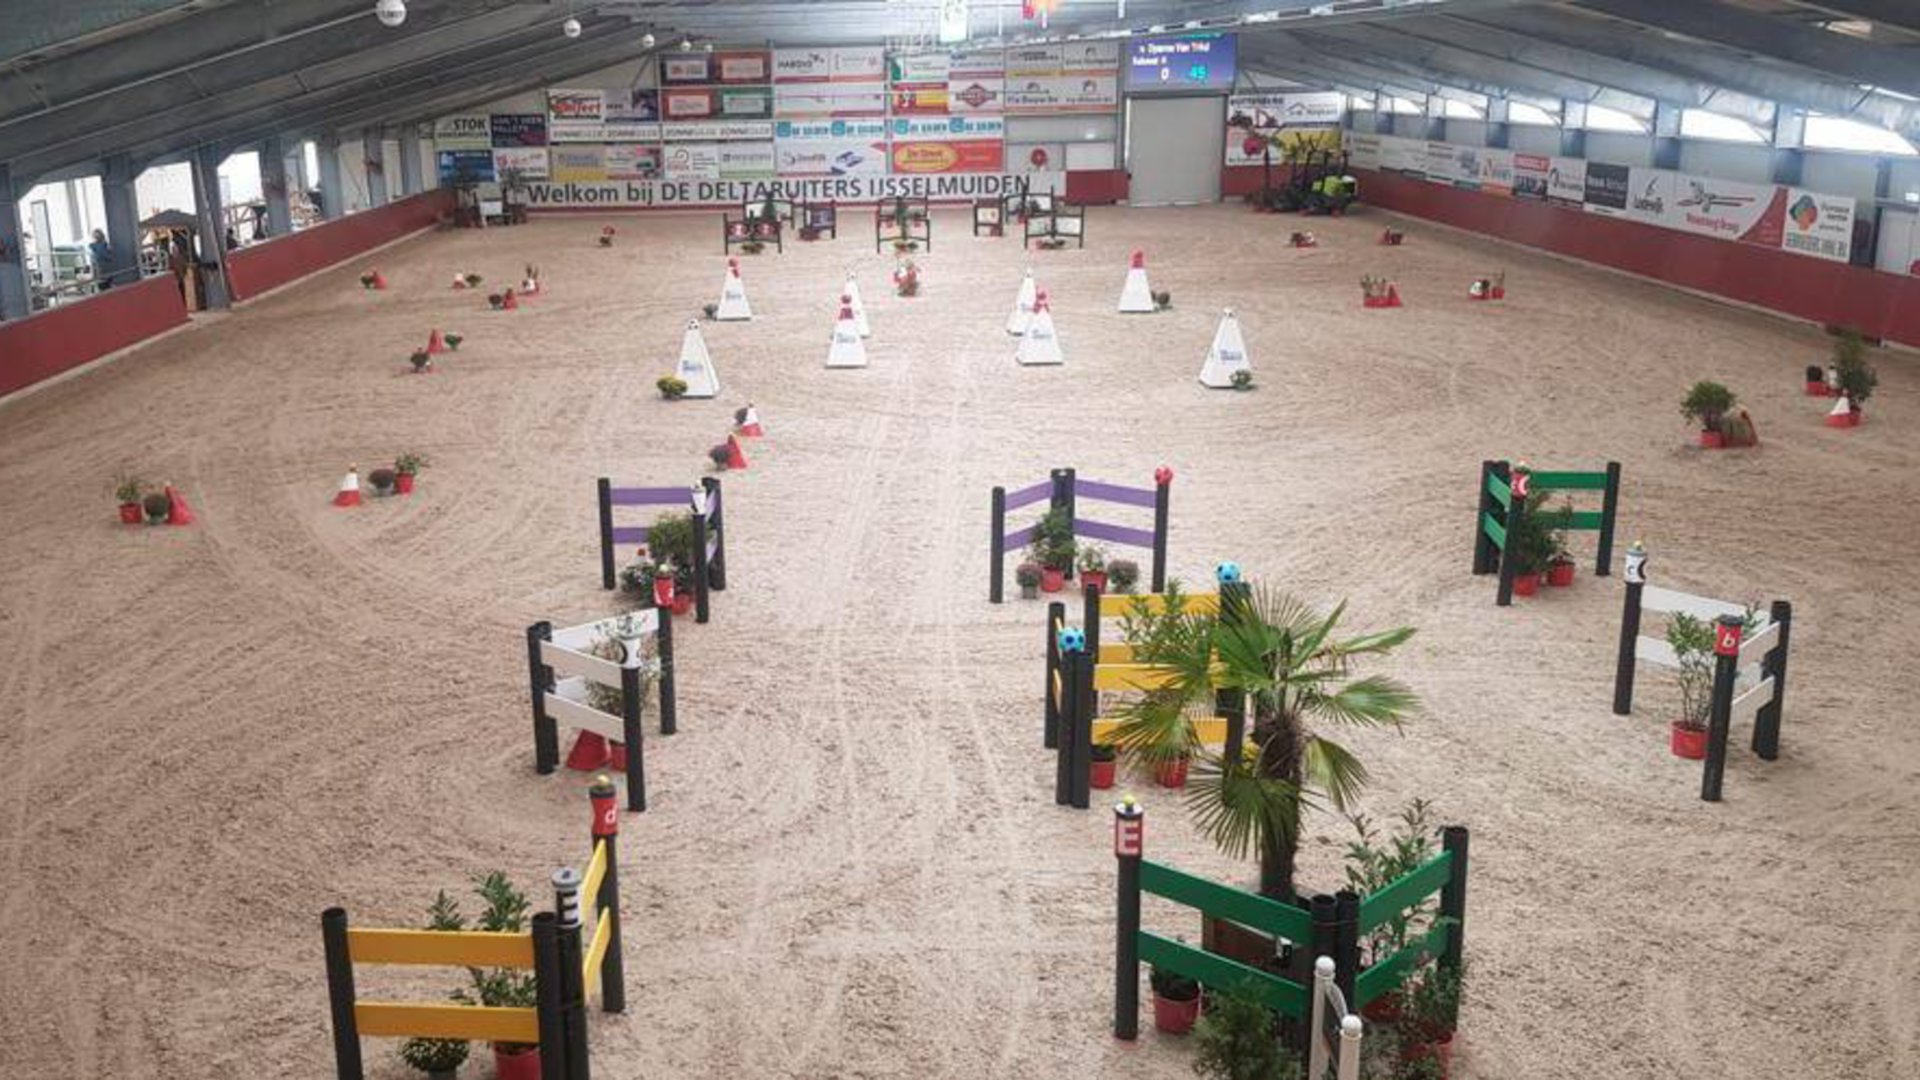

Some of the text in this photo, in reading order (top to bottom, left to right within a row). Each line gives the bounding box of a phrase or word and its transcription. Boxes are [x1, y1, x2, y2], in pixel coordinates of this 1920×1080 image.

[1161, 67, 1170, 80] 0
[454, 118, 486, 130] STOK
[528, 175, 1030, 204] Welkom bij DE DELTARUITERS IJSSELMUIDEN
[1723, 633, 1735, 647] b
[604, 803, 618, 824] d
[1118, 820, 1140, 855] E
[556, 889, 578, 925] E
